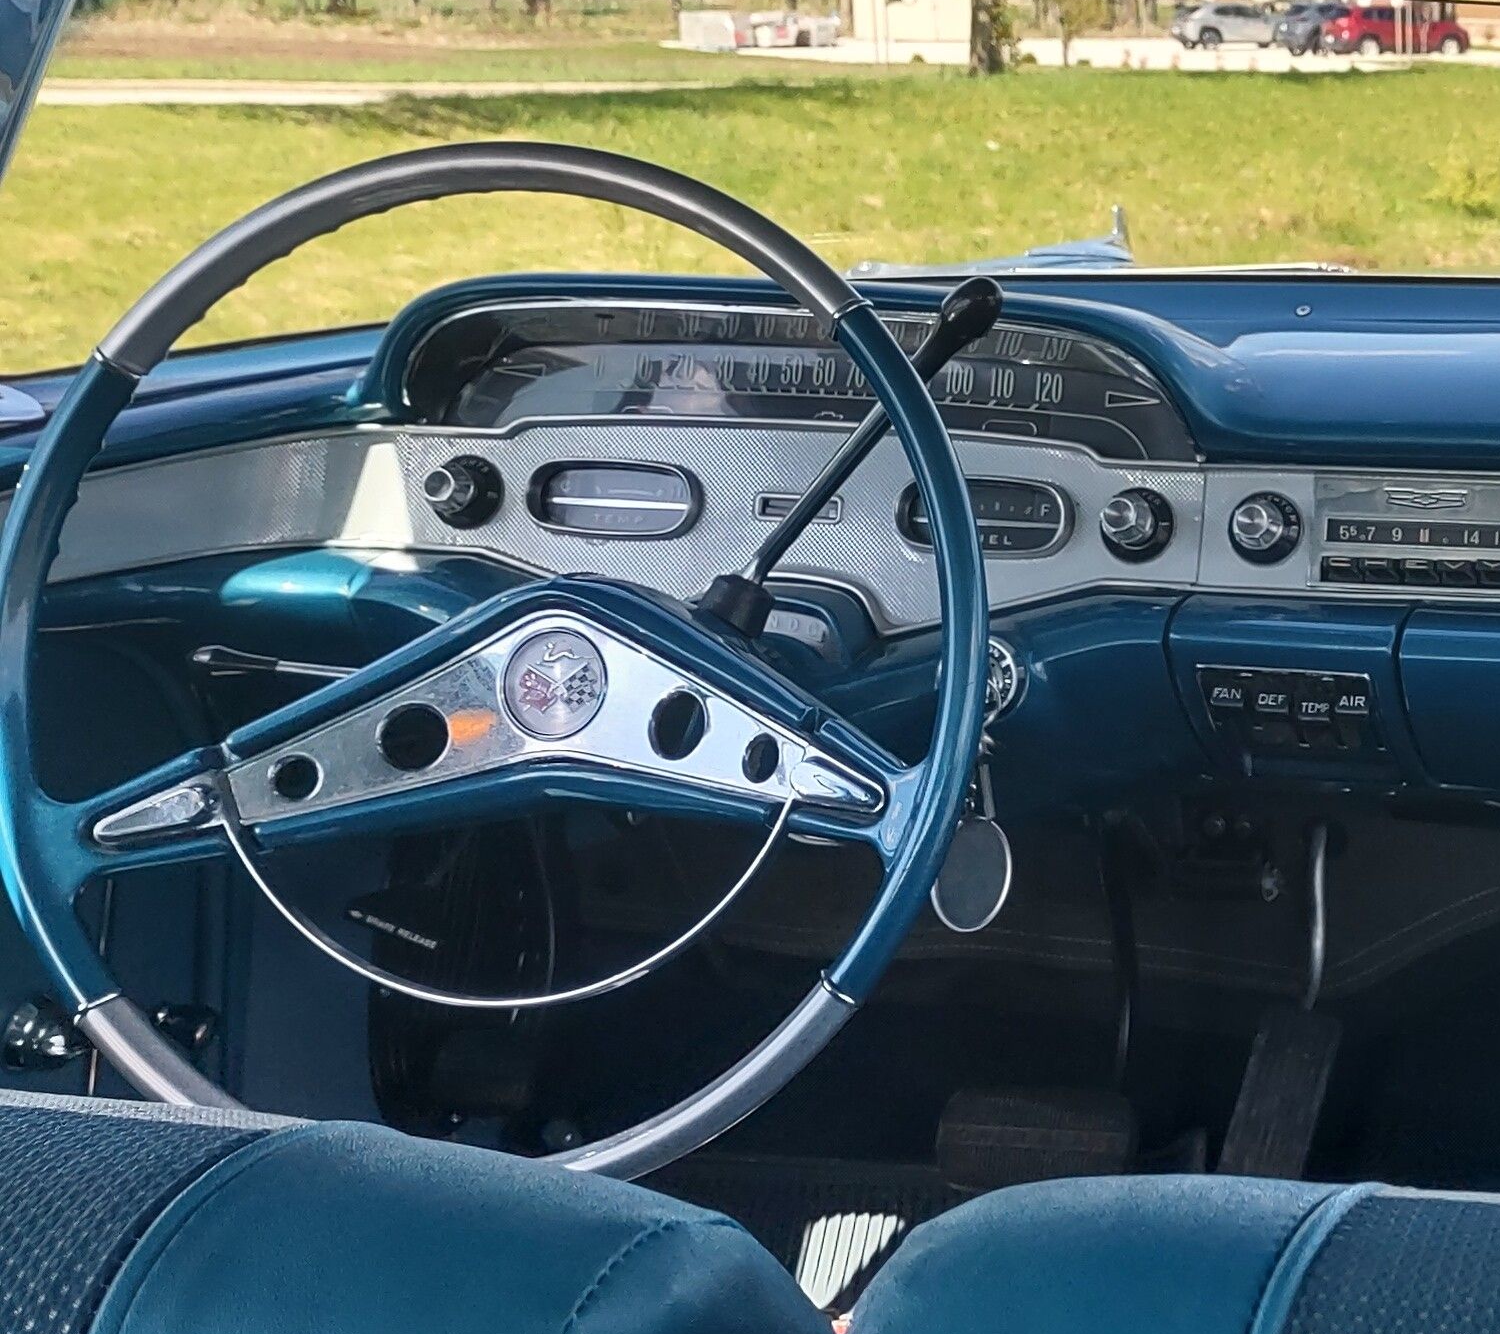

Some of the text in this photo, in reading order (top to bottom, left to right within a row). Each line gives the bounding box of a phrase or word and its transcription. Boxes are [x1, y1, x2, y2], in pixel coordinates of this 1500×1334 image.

[714, 354, 734, 382] 30
[747, 354, 770, 385] 40
[780, 357, 803, 385] 50
[812, 357, 835, 386] 60
[945, 366, 974, 396] 100
[990, 367, 1015, 399] 110
[1035, 371, 1063, 404] 120
[1040, 504, 1051, 517] F
[1366, 526, 1376, 541] 7
[1391, 527, 1403, 542] 9
[1463, 530, 1480, 545] 14
[1212, 687, 1366, 714] FAN DEF TEMP AIR
[397, 927, 437, 949] RELEASE
